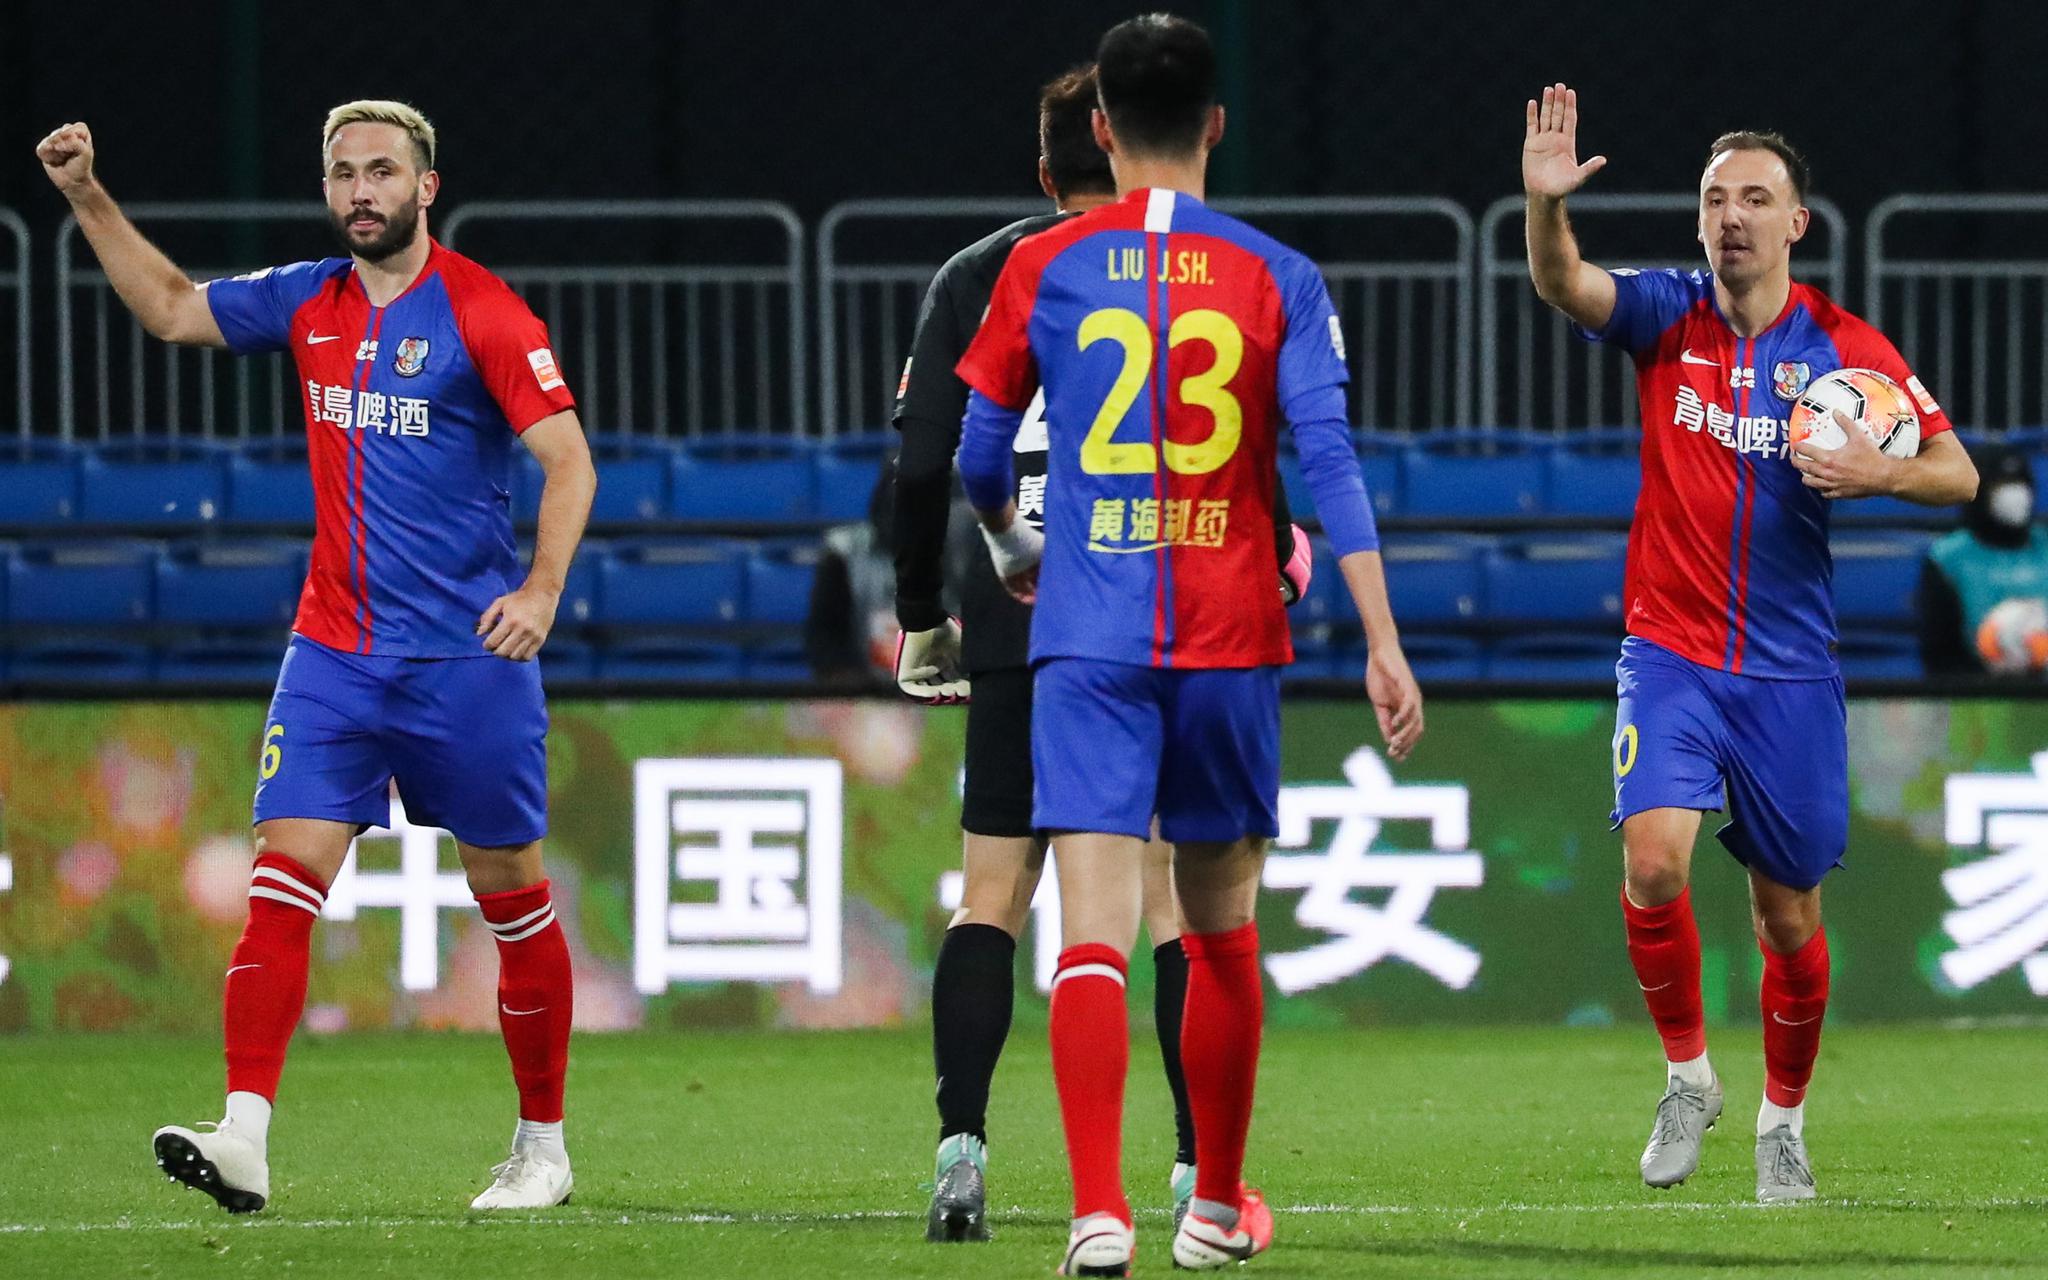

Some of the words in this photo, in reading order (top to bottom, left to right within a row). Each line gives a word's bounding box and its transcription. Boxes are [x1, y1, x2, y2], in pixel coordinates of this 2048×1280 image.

[1107, 248, 1144, 281] LIU
[1157, 250, 1215, 285] J.SH.
[1077, 307, 1244, 475] 23
[1089, 498, 1230, 547] 黄海制药
[261, 724, 284, 780] 6
[320, 745, 1485, 996] 中国安
